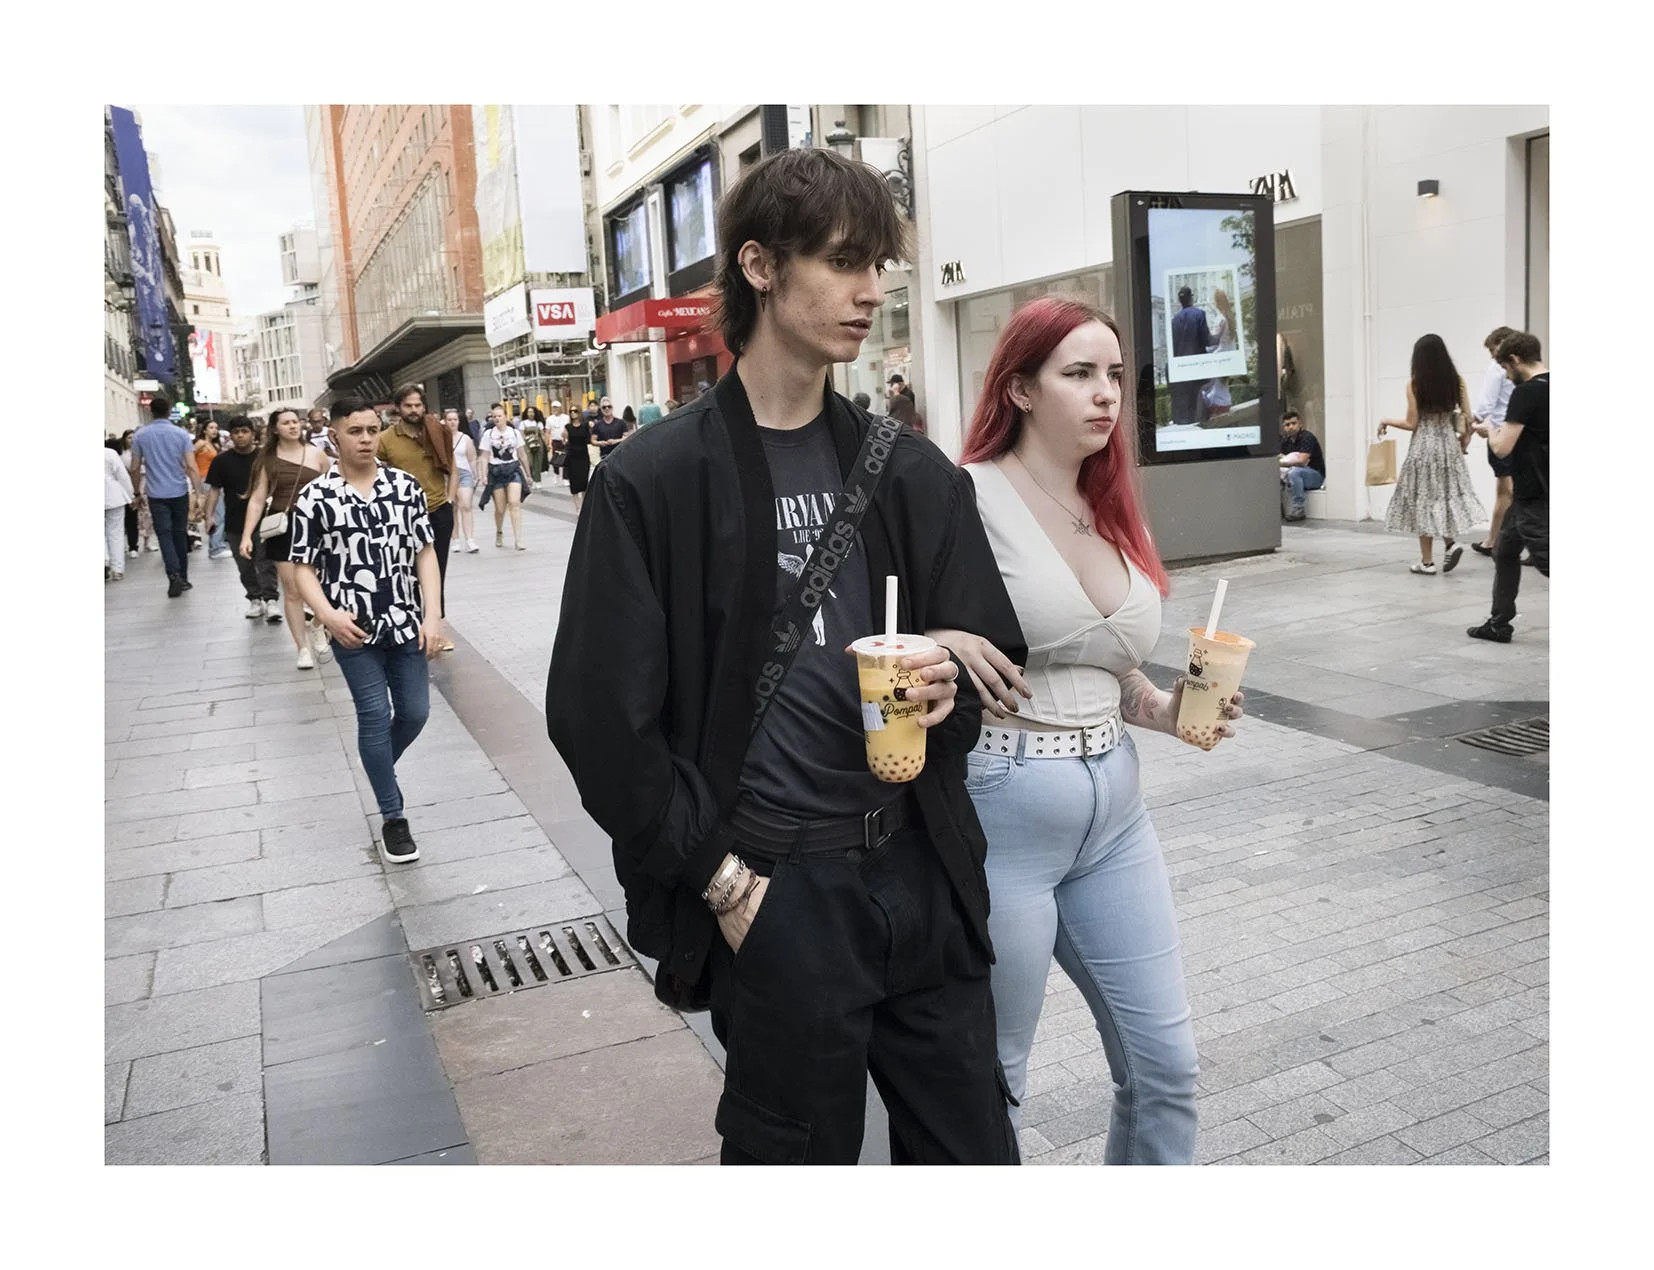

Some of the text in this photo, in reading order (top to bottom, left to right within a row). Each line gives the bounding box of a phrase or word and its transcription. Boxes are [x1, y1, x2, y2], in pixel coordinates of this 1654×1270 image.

[1249, 169, 1297, 201] ZARA
[941, 260, 965, 285] ZARA
[538, 304, 573, 320] VSA
[864, 416, 901, 475] adida
[800, 520, 854, 609] adidas
